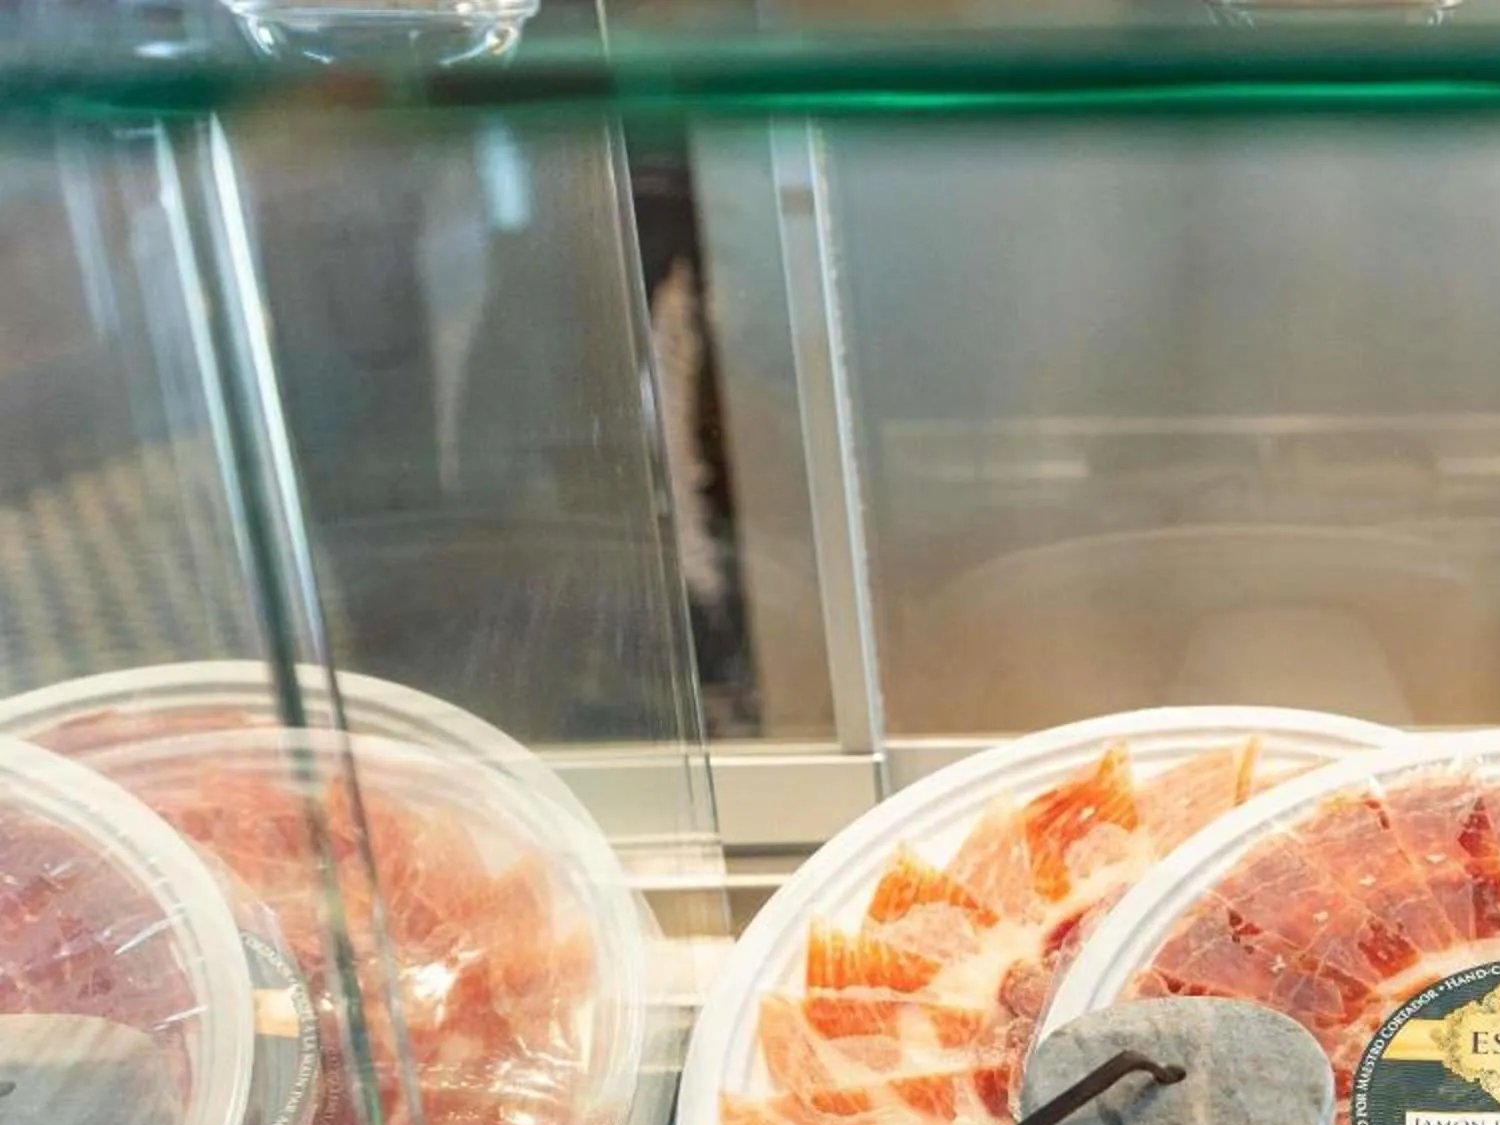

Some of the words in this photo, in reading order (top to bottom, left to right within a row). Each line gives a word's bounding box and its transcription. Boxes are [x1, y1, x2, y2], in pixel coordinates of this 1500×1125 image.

[1381, 989, 1439, 1039] CORTADOR
[1356, 1039, 1385, 1090] MAESTRO
[1355, 1093, 1367, 1117] POR
